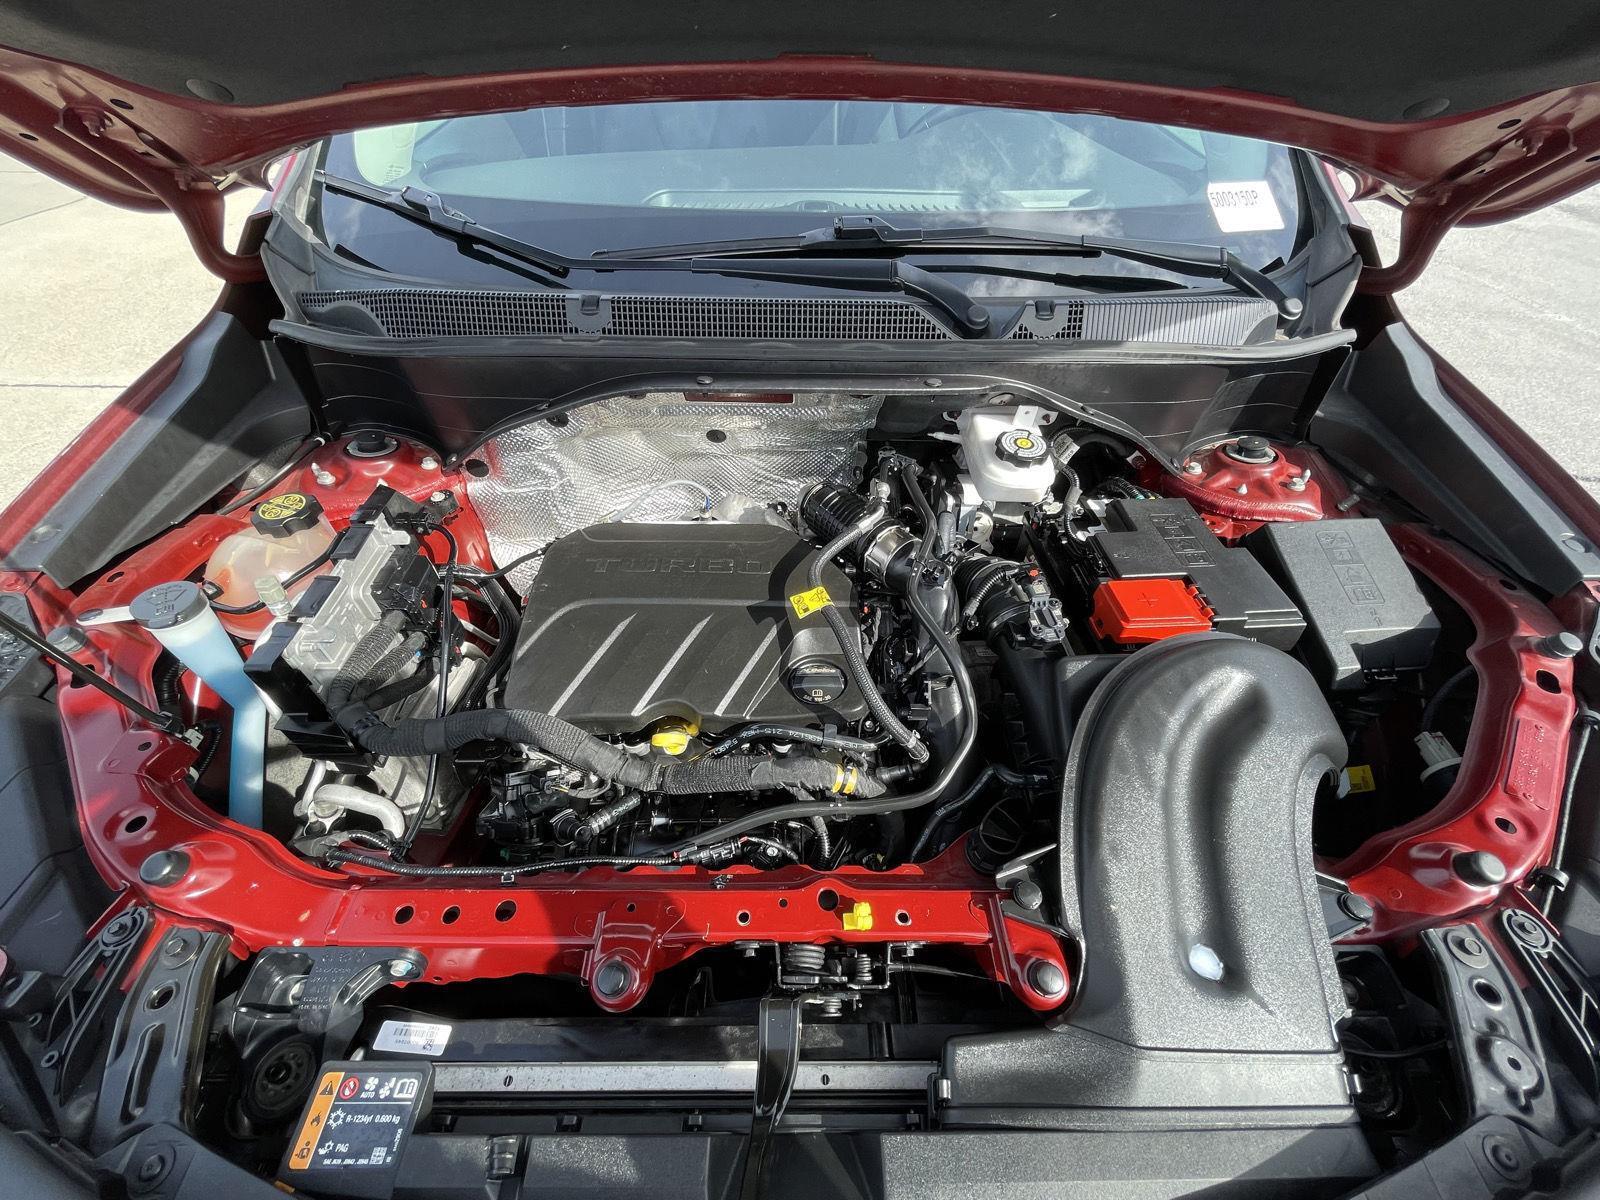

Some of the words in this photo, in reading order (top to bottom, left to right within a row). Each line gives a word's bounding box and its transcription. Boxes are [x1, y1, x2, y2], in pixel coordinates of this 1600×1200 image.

[585, 558, 773, 575] TURBO
[360, 1091, 375, 1099] AUTO
[345, 1114, 373, 1124] R-1234yf
[374, 1114, 392, 1123] 0.600
[391, 1114, 401, 1125] kg
[335, 1143, 349, 1153] PAG
